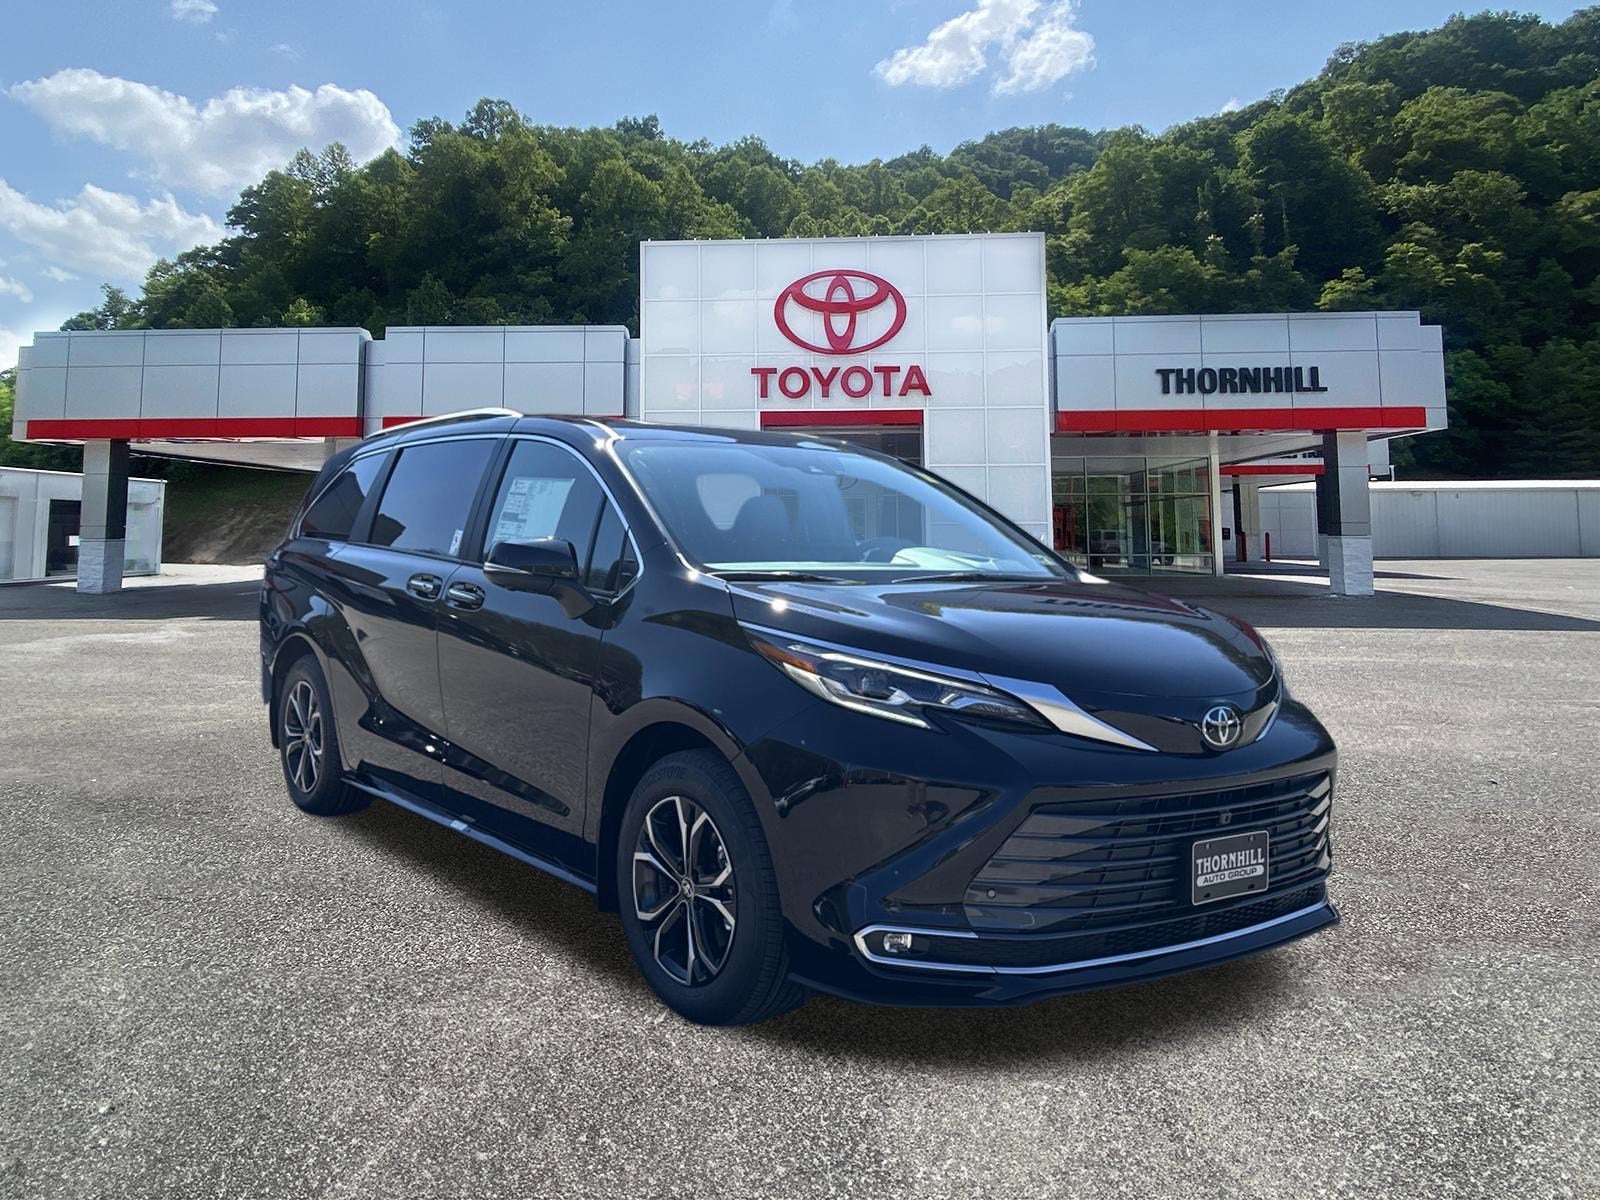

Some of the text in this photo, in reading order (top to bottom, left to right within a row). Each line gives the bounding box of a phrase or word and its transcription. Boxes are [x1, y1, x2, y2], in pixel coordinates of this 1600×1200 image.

[751, 365, 932, 399] TOYOTA
[1156, 366, 1328, 394] THORNHILL
[1196, 848, 1264, 874] THORNHILL
[1203, 867, 1257, 884] AUTO GROUP
